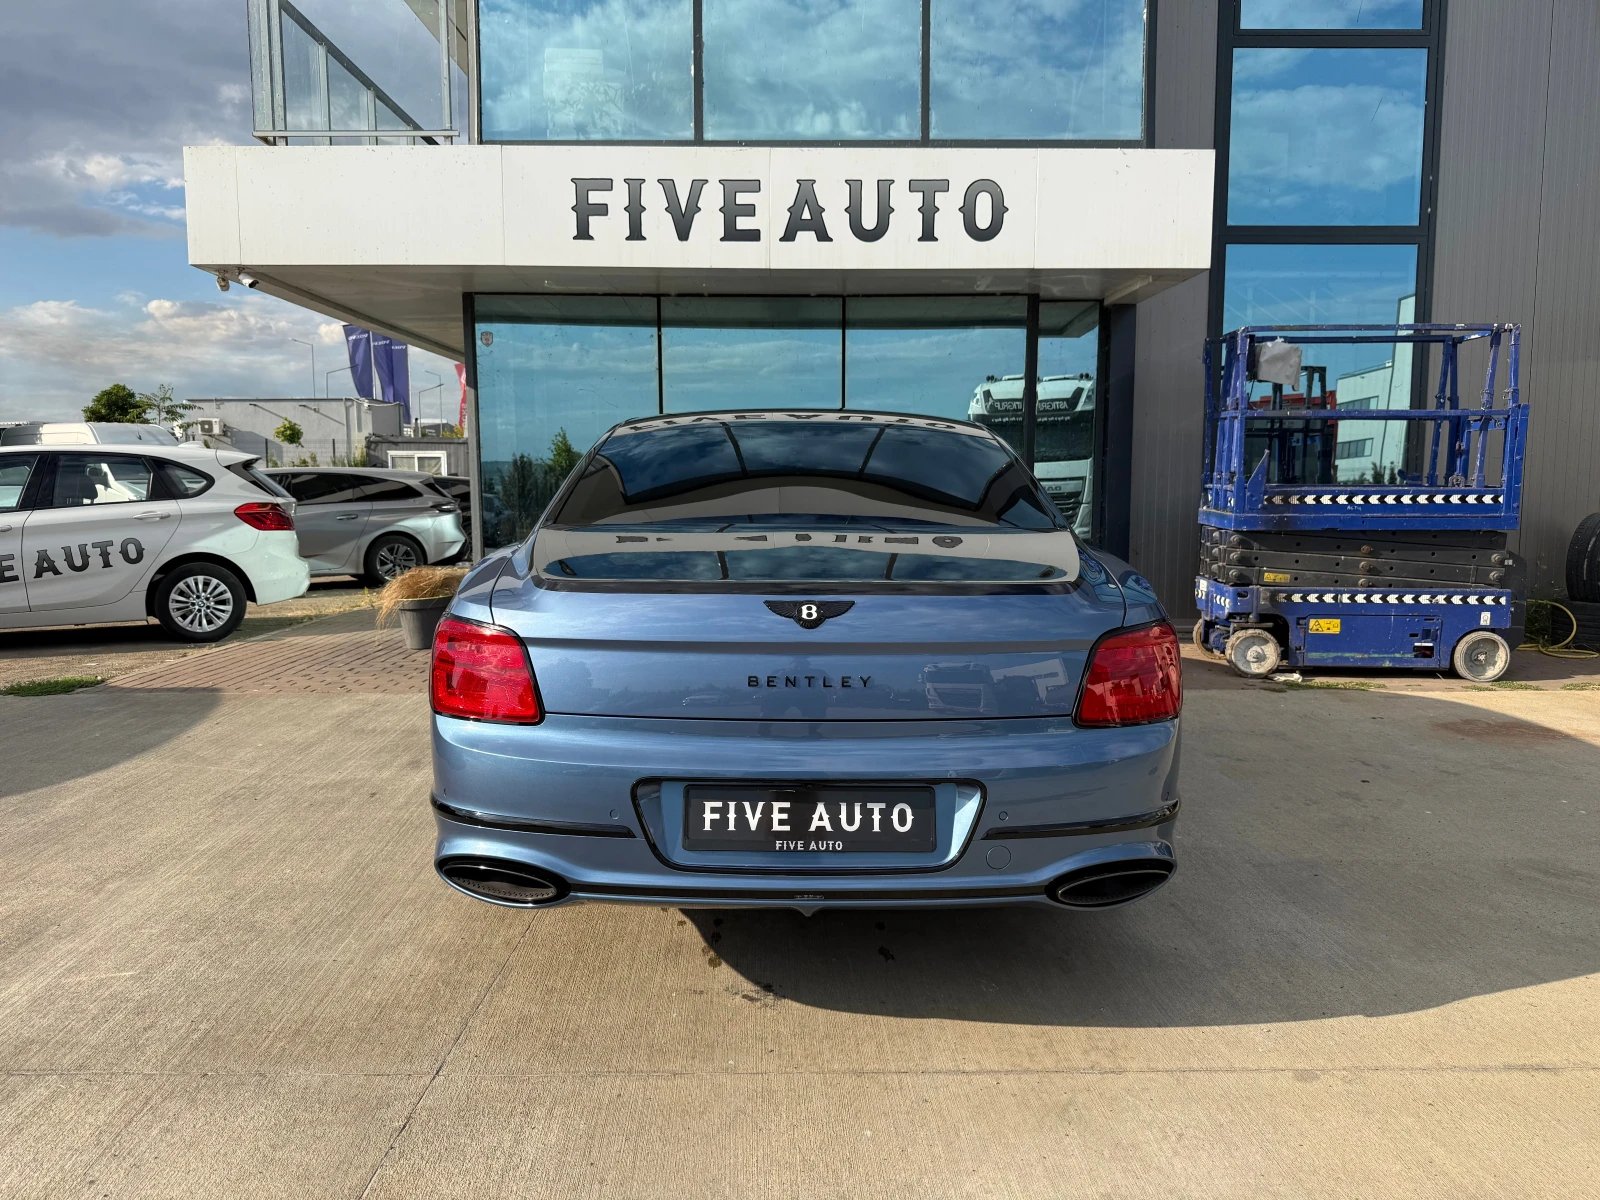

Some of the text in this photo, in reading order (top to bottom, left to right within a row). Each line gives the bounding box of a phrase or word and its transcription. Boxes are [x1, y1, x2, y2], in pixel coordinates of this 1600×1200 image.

[33, 537, 146, 579] AUTO
[801, 604, 818, 620] B
[747, 675, 872, 688] BENTLEY
[702, 801, 915, 833] FIVE AUTO
[775, 840, 843, 851] FIVE AUTO
